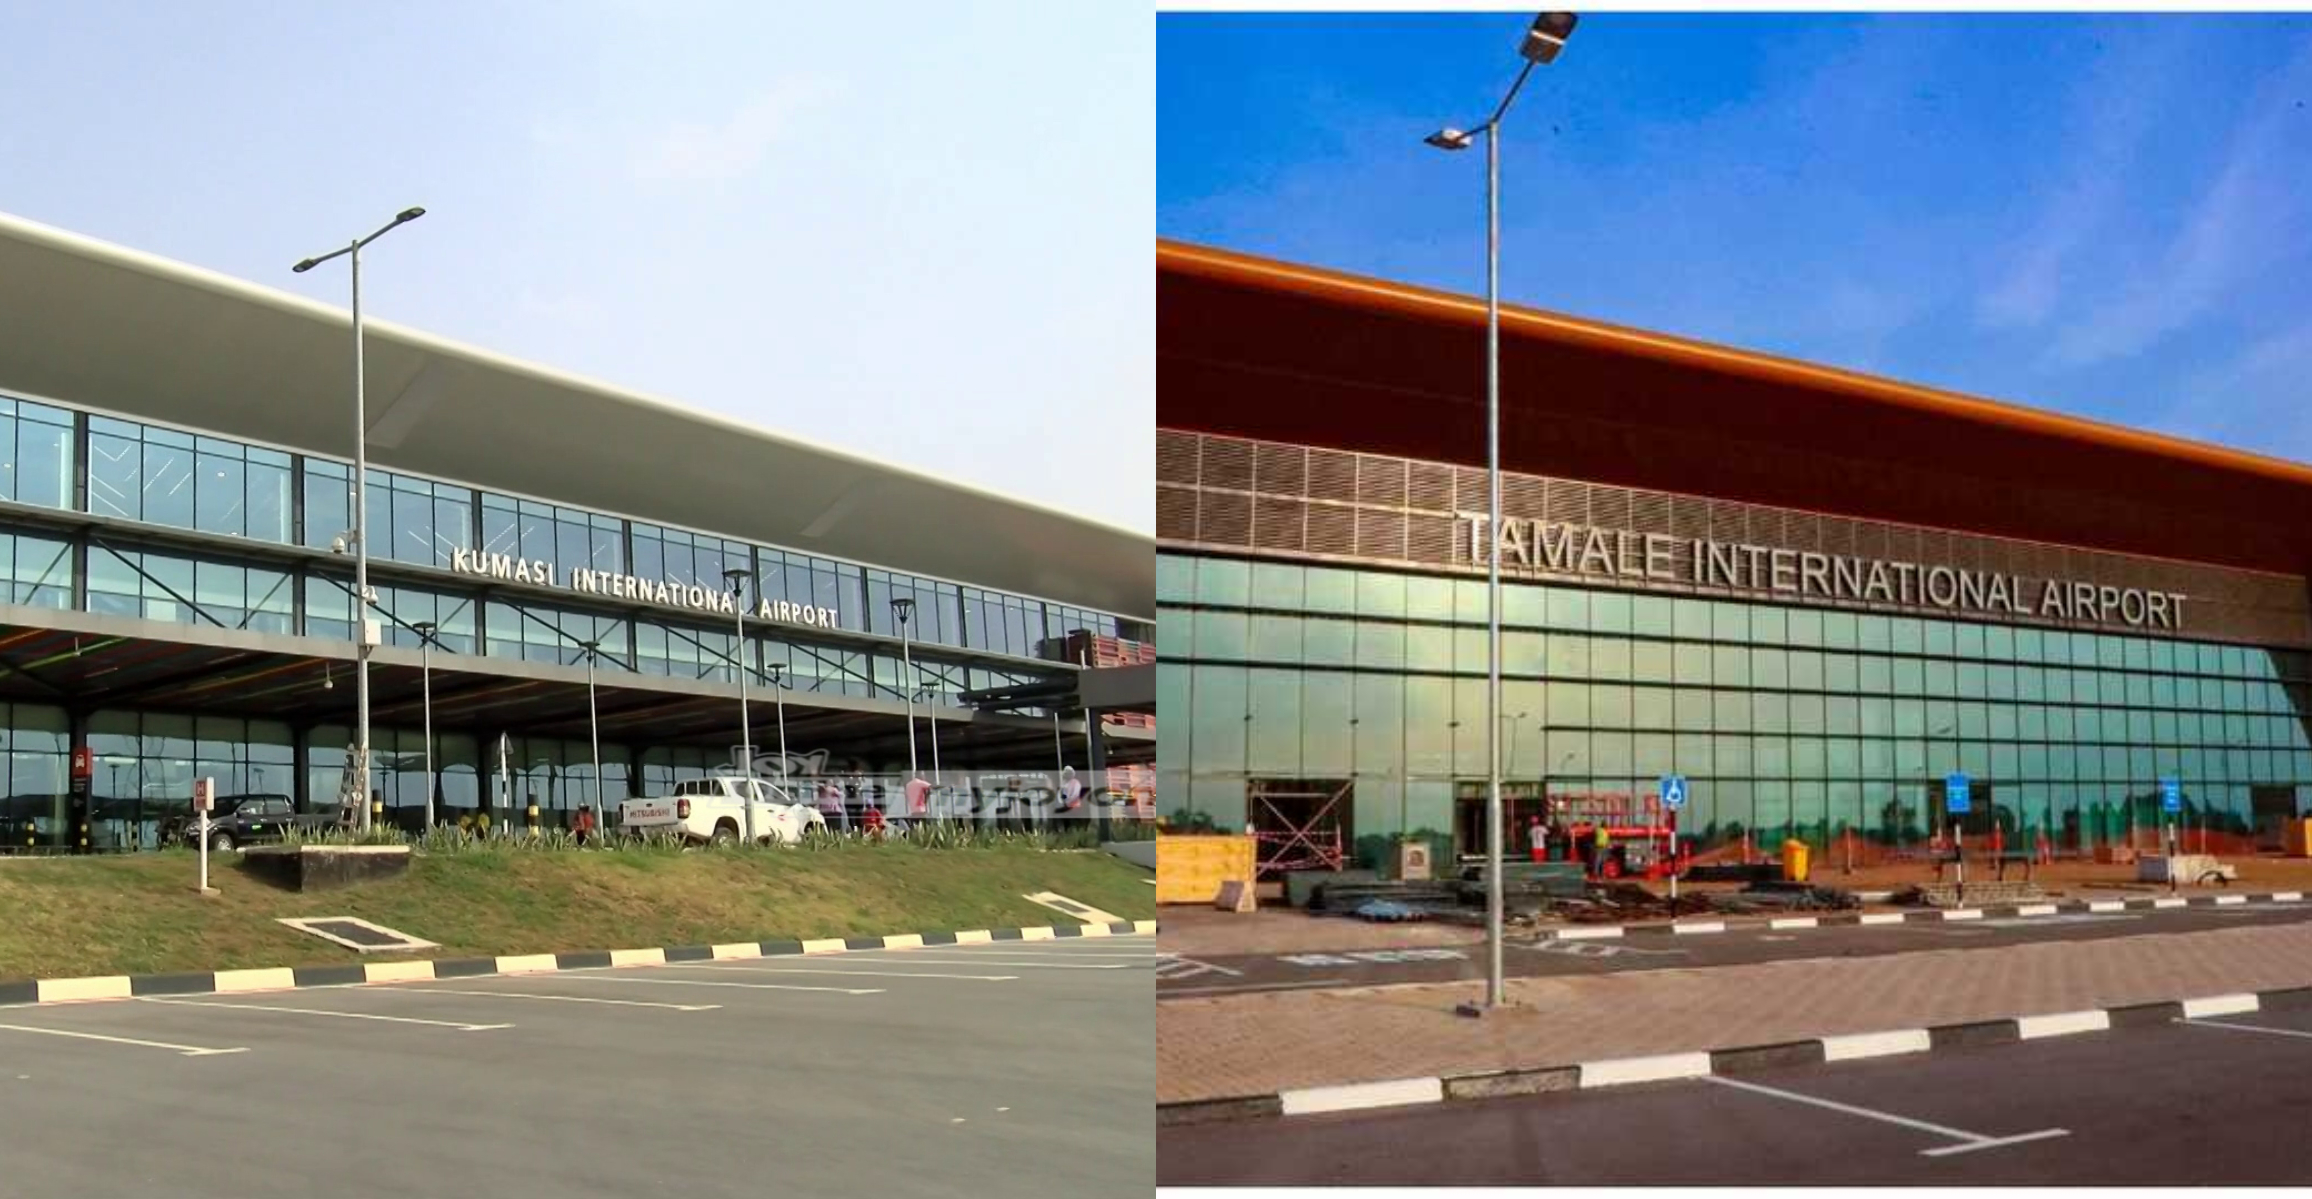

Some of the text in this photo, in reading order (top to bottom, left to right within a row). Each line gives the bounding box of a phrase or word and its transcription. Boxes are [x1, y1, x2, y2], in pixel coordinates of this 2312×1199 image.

[453, 546, 837, 628] KUMASI INTERNATIONA AIRPORT
[1456, 510, 2187, 629] TAMALE INTERNATIONAL AIRPORT
